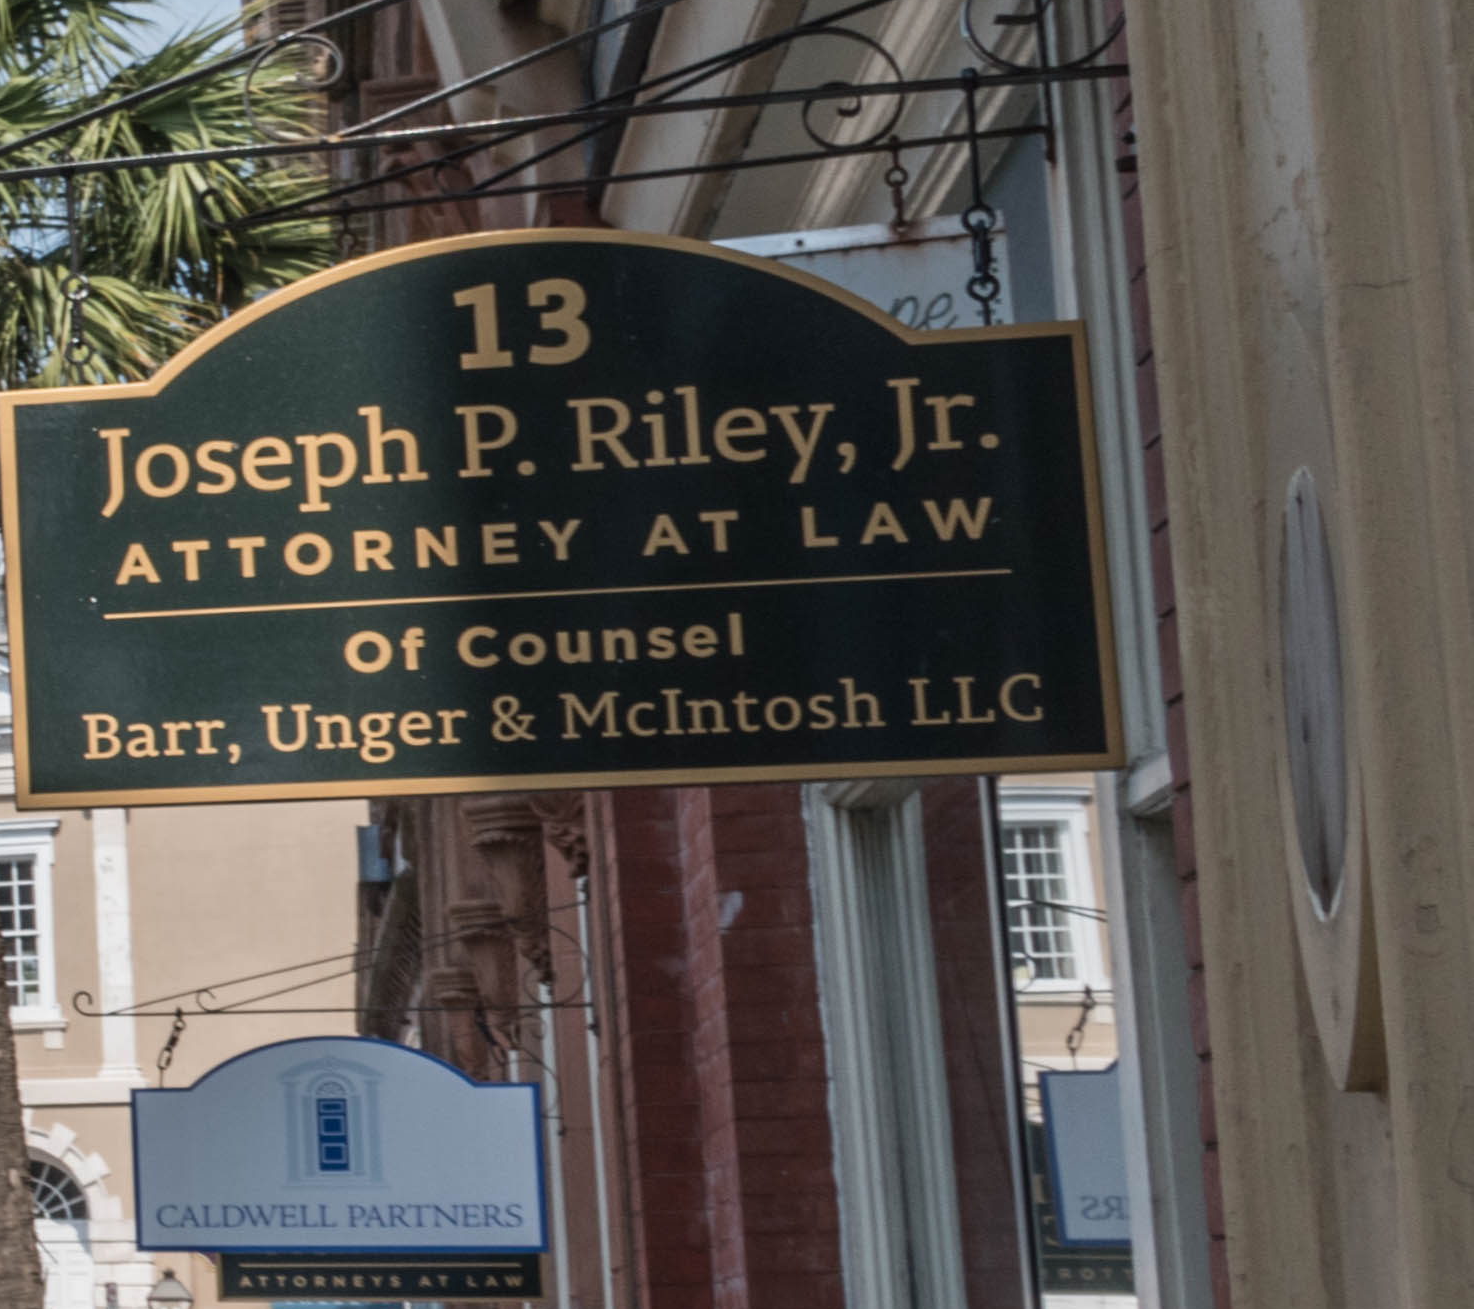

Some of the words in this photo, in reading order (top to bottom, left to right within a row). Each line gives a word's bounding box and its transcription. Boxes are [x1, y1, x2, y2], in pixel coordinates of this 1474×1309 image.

[453, 278, 590, 371] 13
[98, 404, 429, 519] Joseph
[455, 405, 537, 478] P.
[568, 385, 857, 483] Riley,
[889, 378, 999, 473] Jr.
[116, 519, 582, 586] ATTORNEY
[643, 511, 739, 556] AT
[803, 497, 992, 548] LAW
[343, 626, 426, 675] Of
[458, 612, 745, 668] Counsel
[81, 712, 242, 766] Barr,
[260, 702, 468, 765] Unger
[490, 696, 536, 742] &
[560, 678, 885, 740] McIntosh
[911, 672, 1044, 726] LLC
[156, 1203, 338, 1230] CALDWELL
[348, 1203, 523, 1229] PARTNERS
[238, 1273, 403, 1289] ATTORNEYS
[418, 1273, 452, 1288] AT
[466, 1272, 525, 1288] LAW
